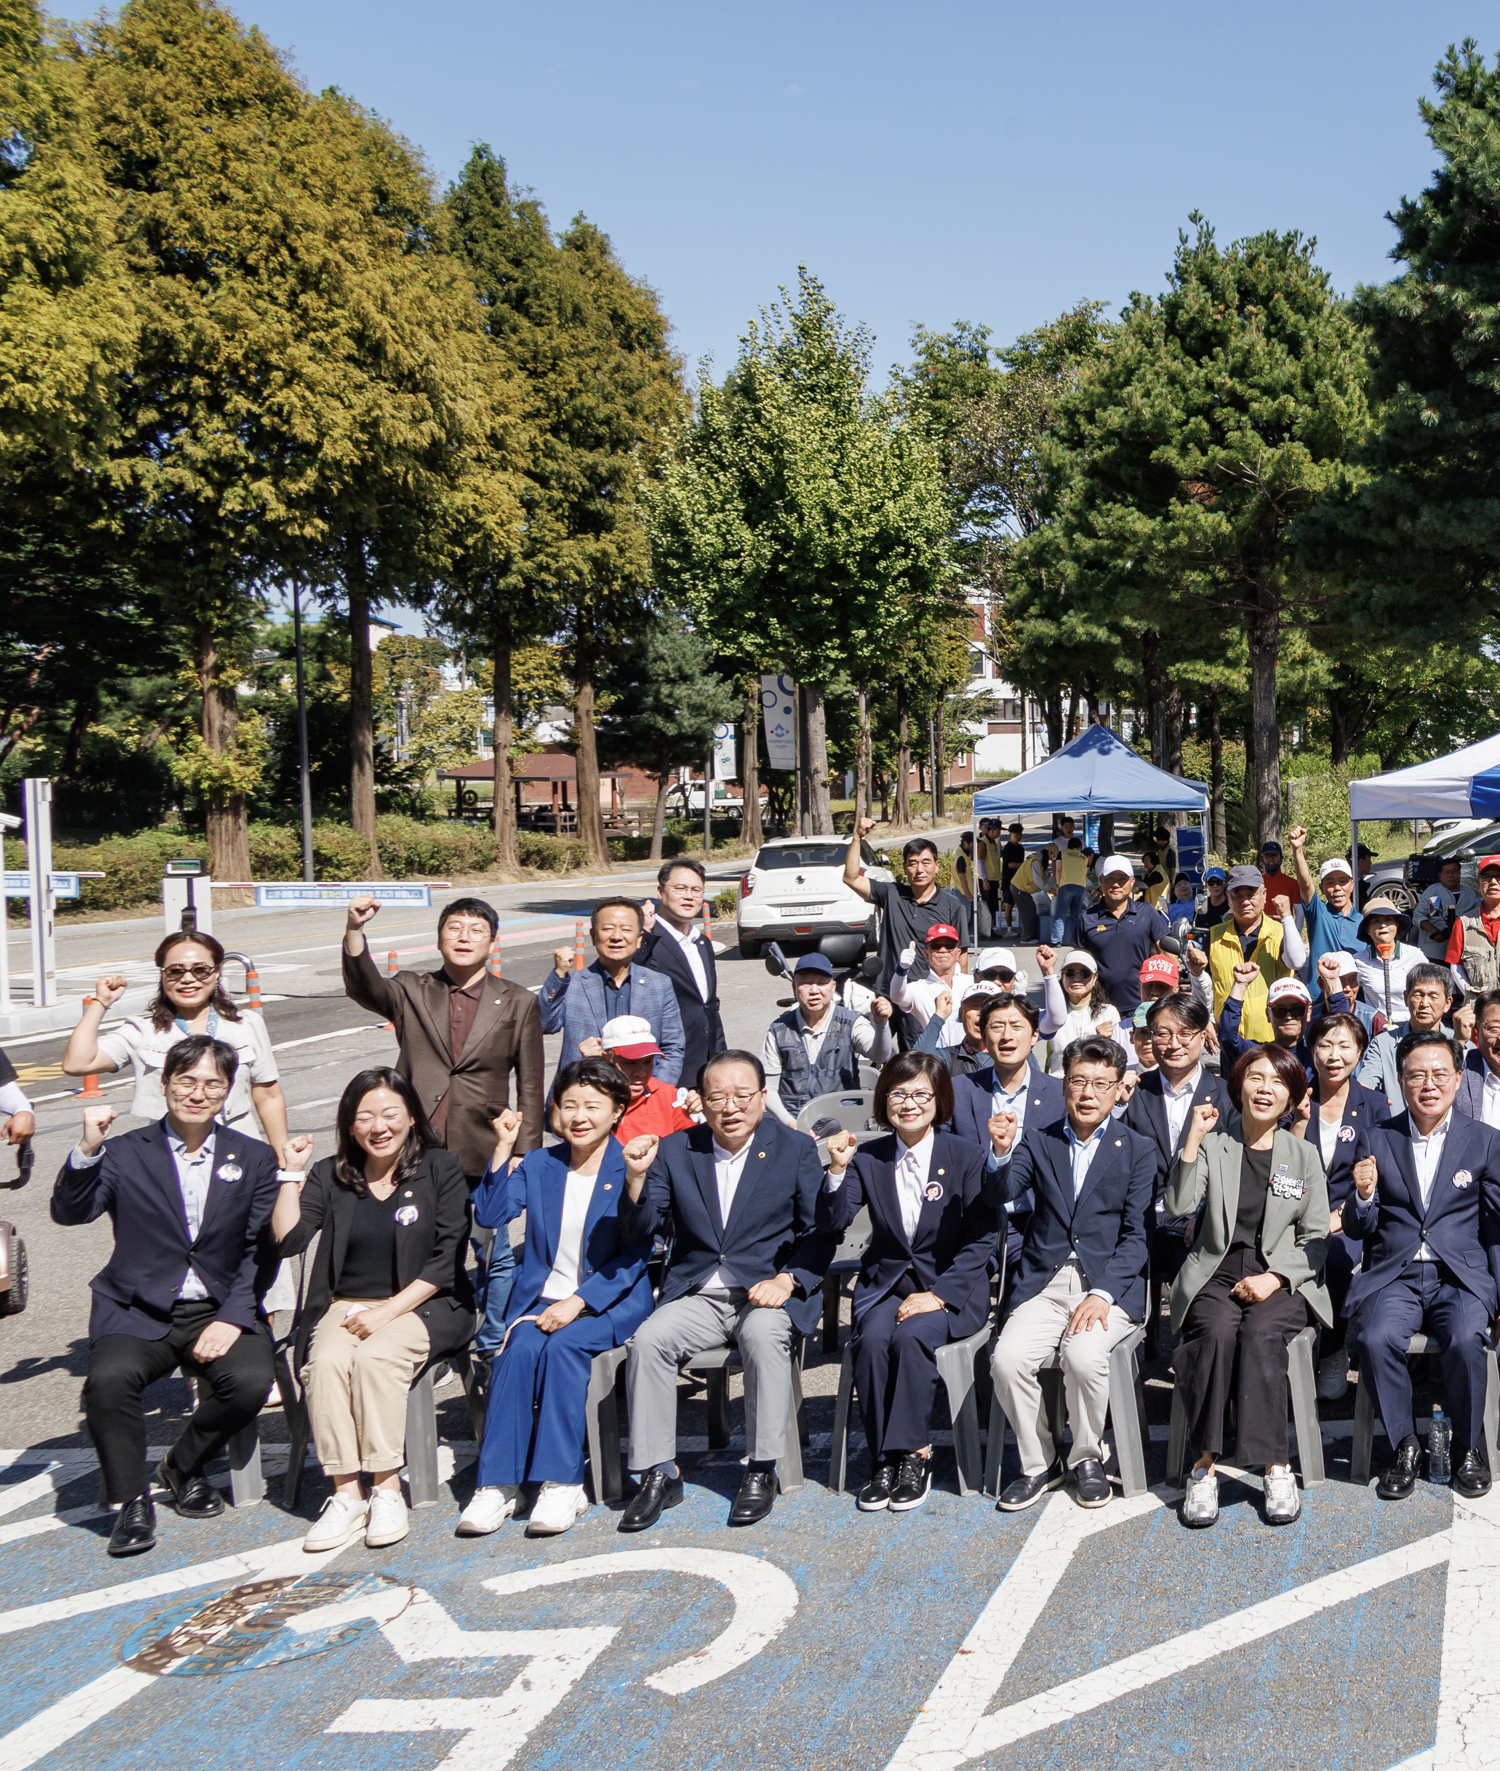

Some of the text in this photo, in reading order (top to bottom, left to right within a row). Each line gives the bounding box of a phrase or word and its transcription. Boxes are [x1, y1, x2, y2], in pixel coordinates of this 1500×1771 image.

[375, 890, 394, 898] 주시기
[803, 905, 820, 913] 3651
[1148, 959, 1174, 968] PEARLY
[972, 984, 995, 993] JDX
[1273, 1173, 1304, 1189] 국회의원
[1272, 1183, 1303, 1199] 한정애
